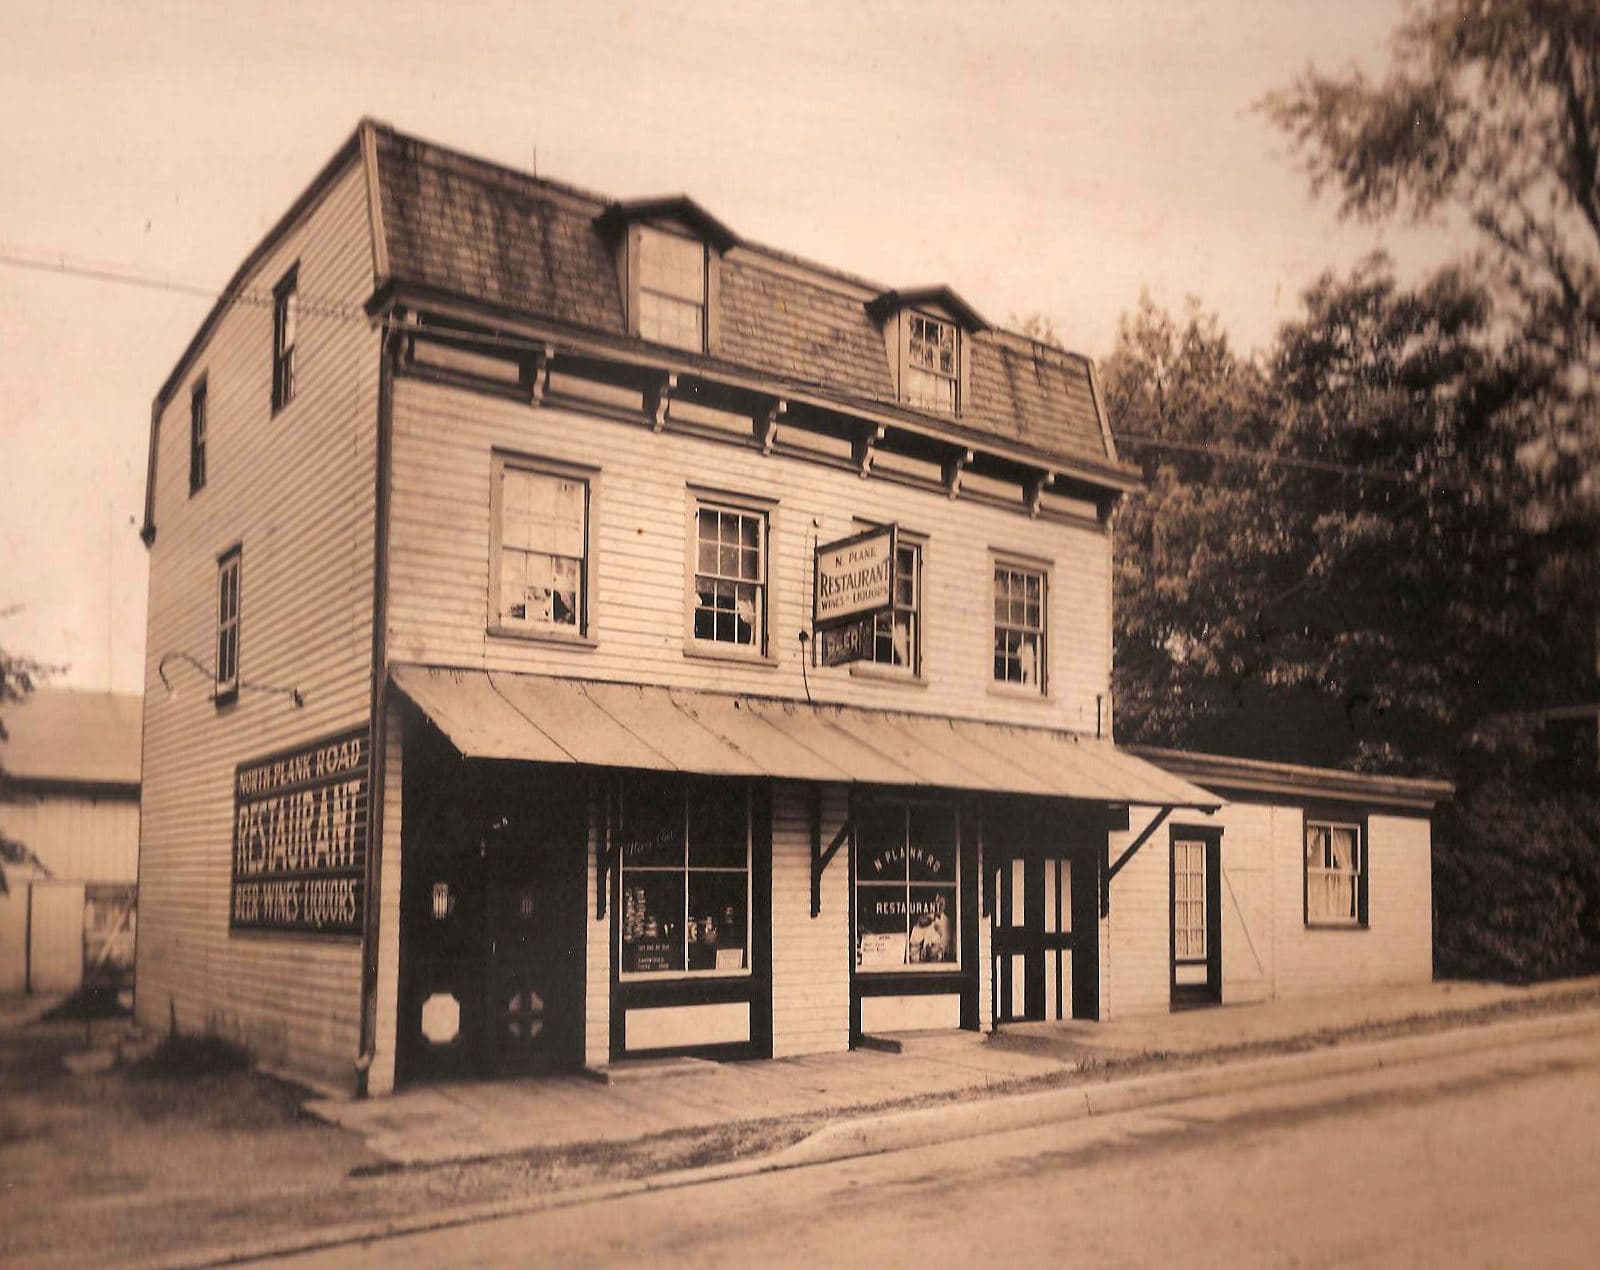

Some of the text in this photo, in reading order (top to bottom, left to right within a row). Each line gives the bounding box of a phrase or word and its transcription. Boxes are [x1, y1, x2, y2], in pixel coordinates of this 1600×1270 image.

[849, 547, 877, 564] PLANK
[820, 558, 889, 598] RESTAURANT
[239, 738, 361, 794] NORTH PLANK ROAD
[237, 779, 361, 876] RESTAURANT
[885, 847, 923, 865] PLANK
[235, 878, 357, 928] BEER WINES LIQUORS
[876, 901, 940, 915] RESTAURANT
